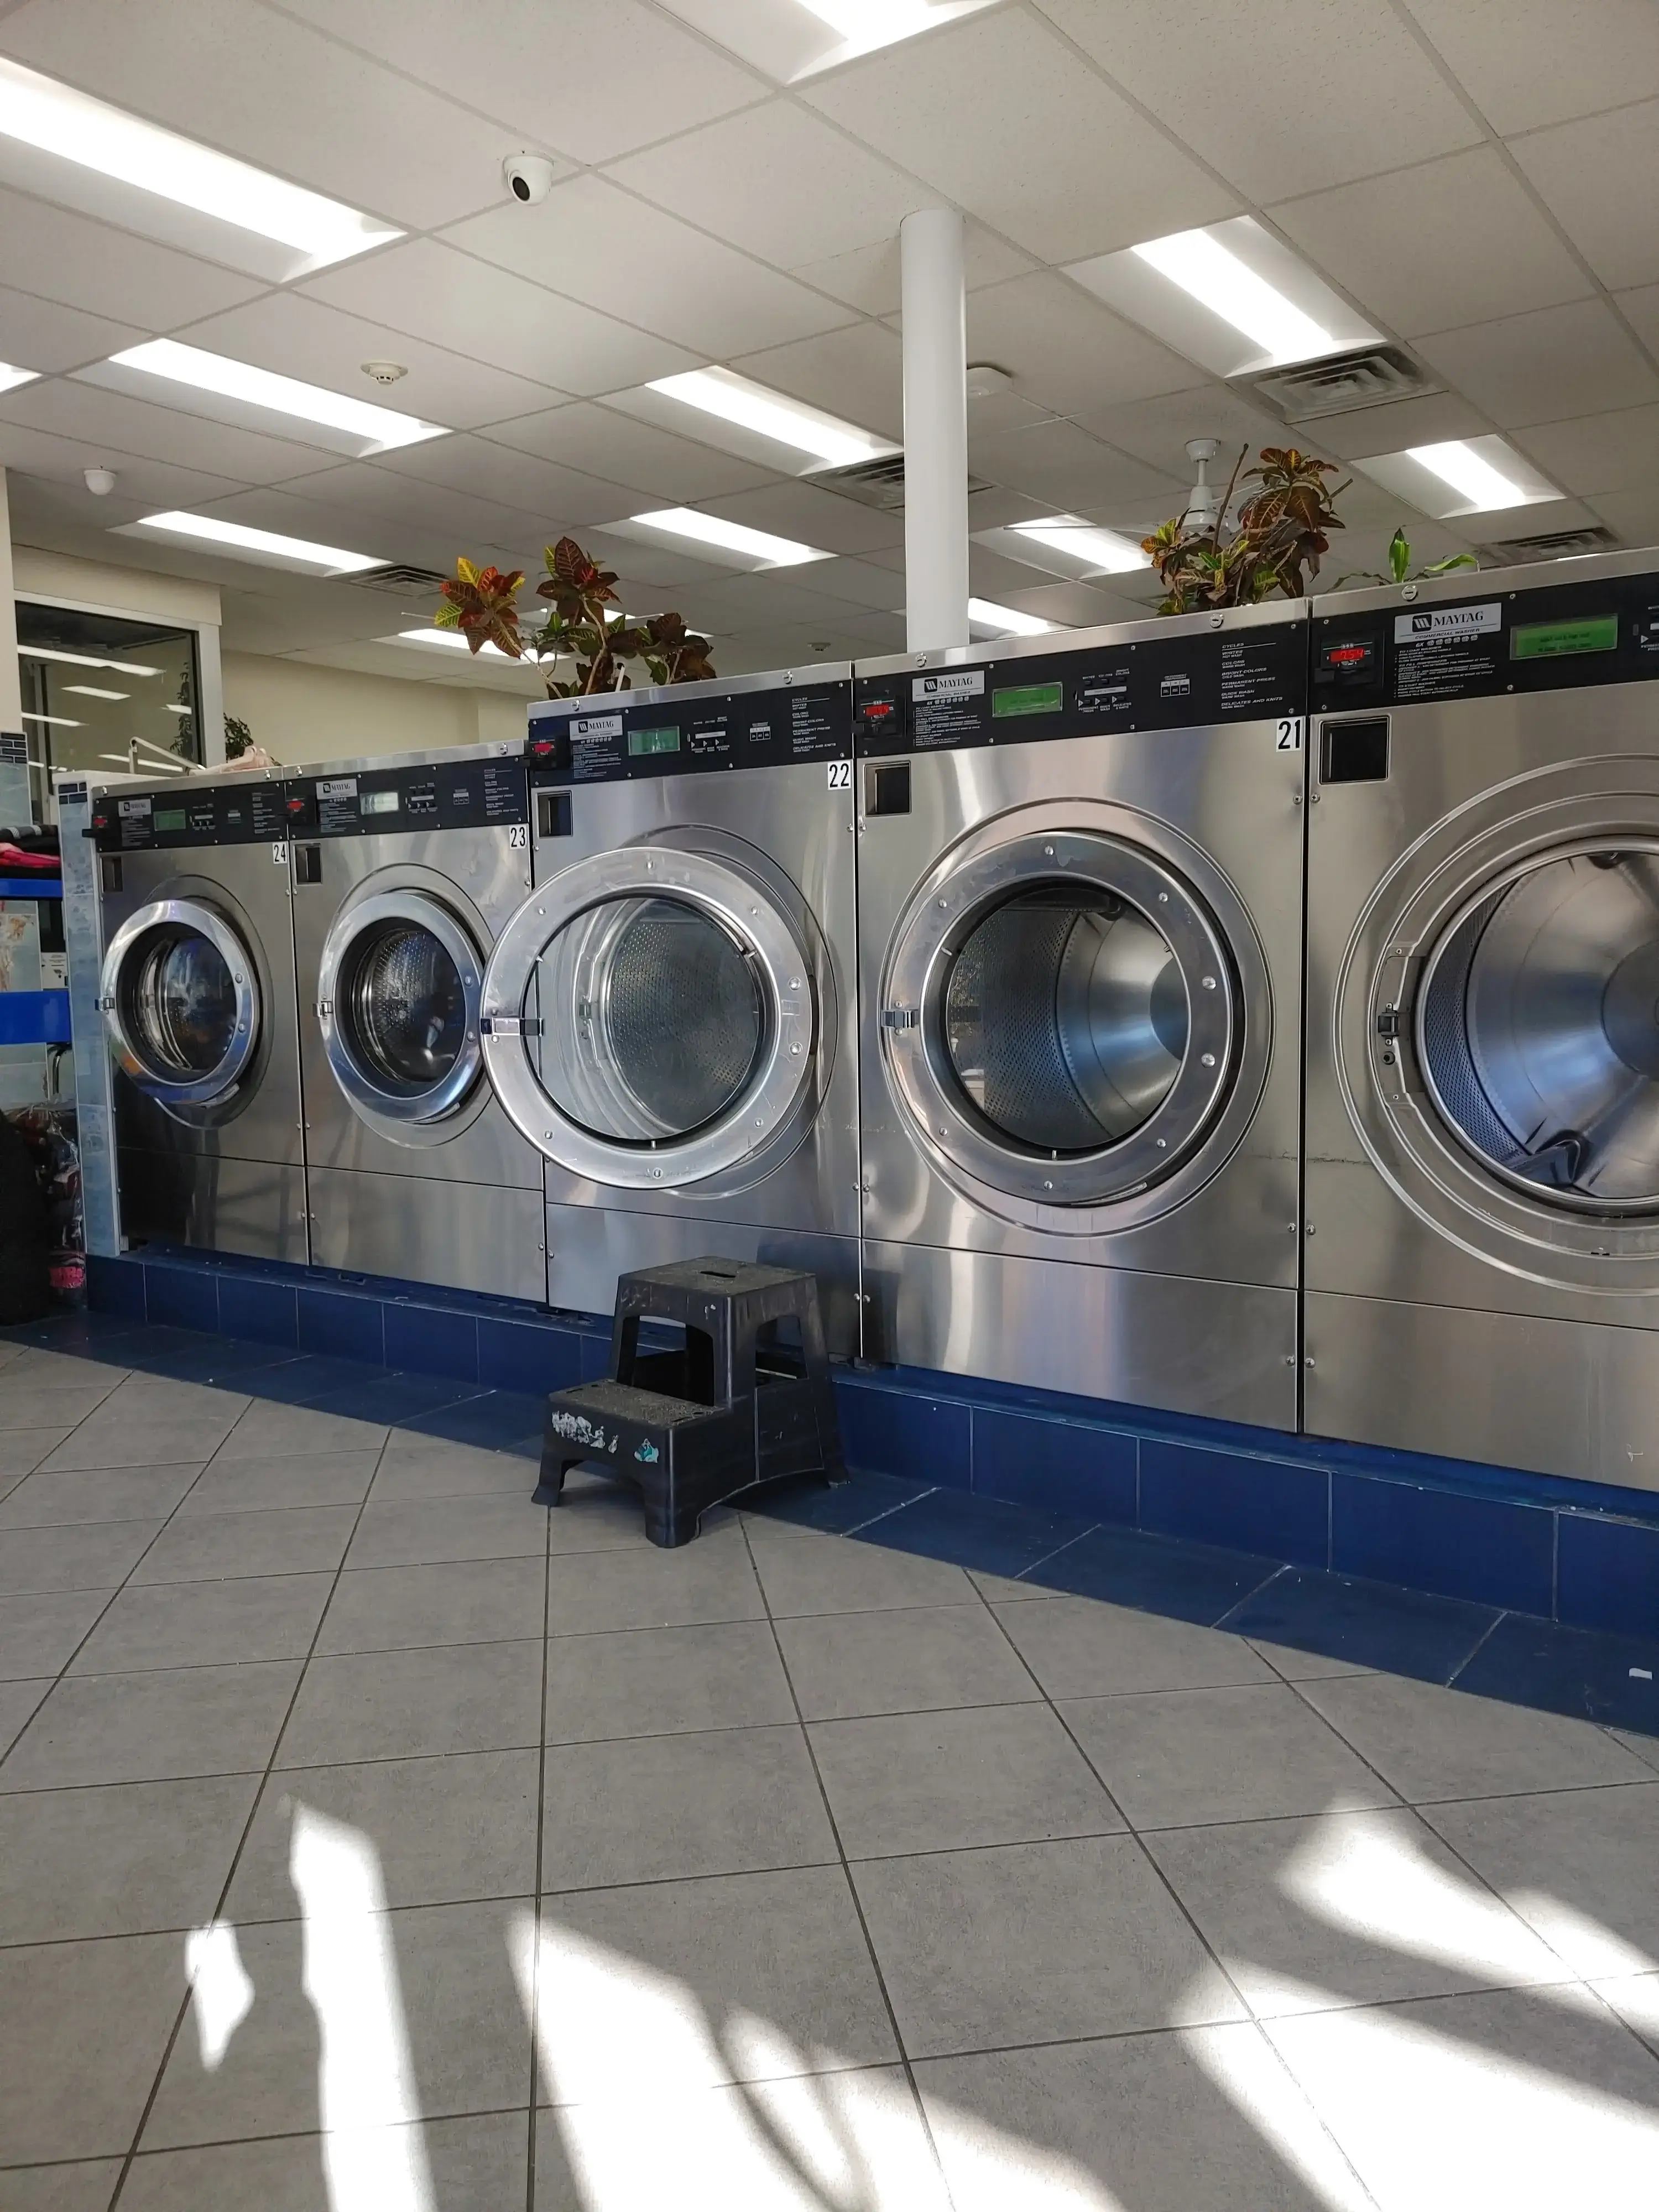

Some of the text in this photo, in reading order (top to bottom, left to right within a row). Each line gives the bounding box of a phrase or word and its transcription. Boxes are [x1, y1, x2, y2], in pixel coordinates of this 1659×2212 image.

[1433, 611, 1484, 627] MAYTAG
[939, 677, 973, 688] MAYTAG
[589, 721, 614, 730] MAYTAG
[1278, 719, 1301, 749] 21
[829, 763, 849, 787] 22
[510, 827, 525, 847] 23
[274, 843, 286, 862] 24
